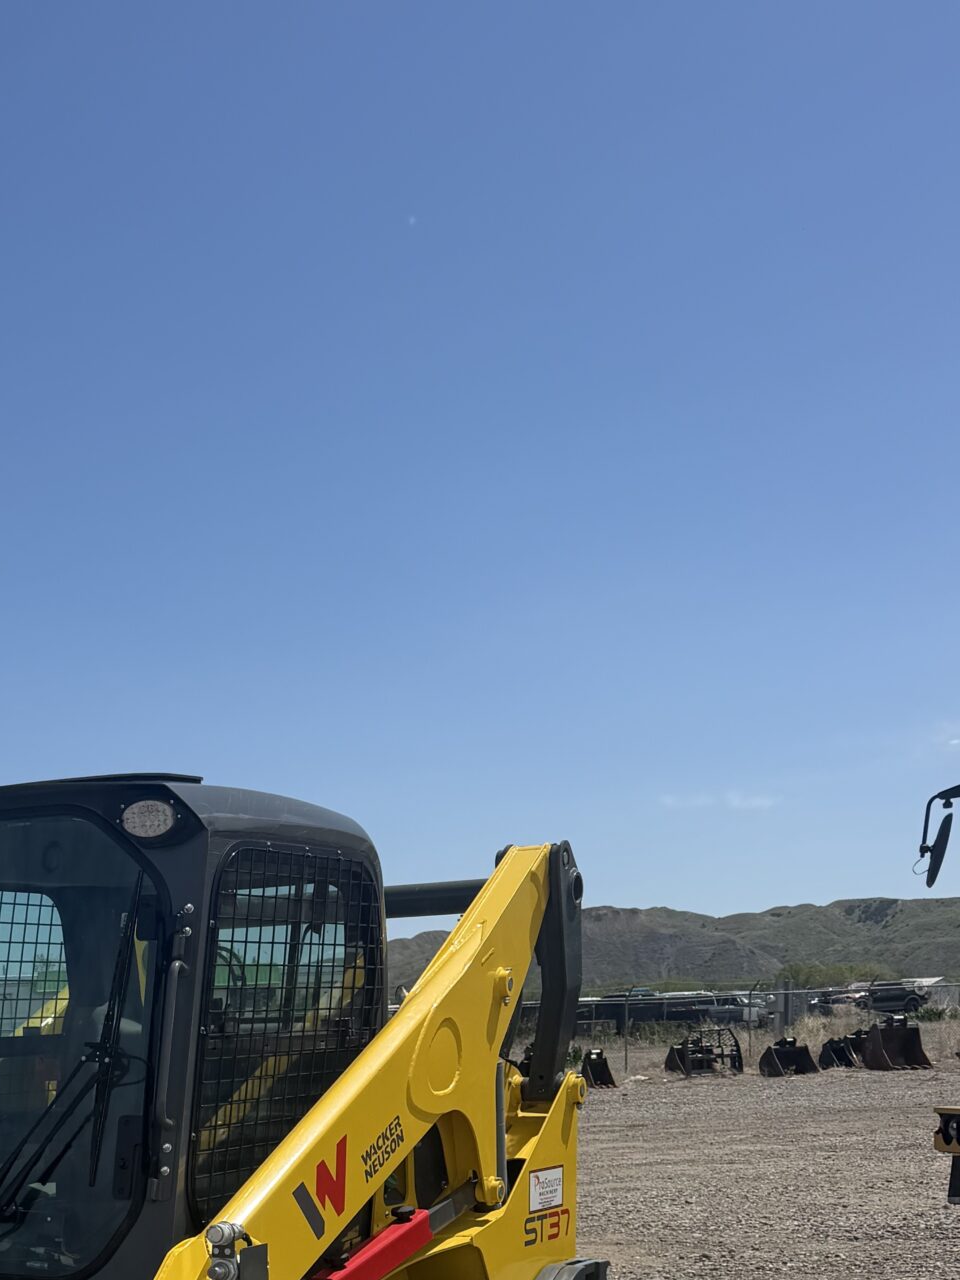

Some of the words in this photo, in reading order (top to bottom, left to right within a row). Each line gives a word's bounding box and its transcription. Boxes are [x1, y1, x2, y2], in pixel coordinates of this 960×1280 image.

[360, 1115, 402, 1166] WACKER
[364, 1128, 404, 1184] NEUSON
[533, 1174, 562, 1192] ProSource
[524, 1208, 570, 1247] ST37
